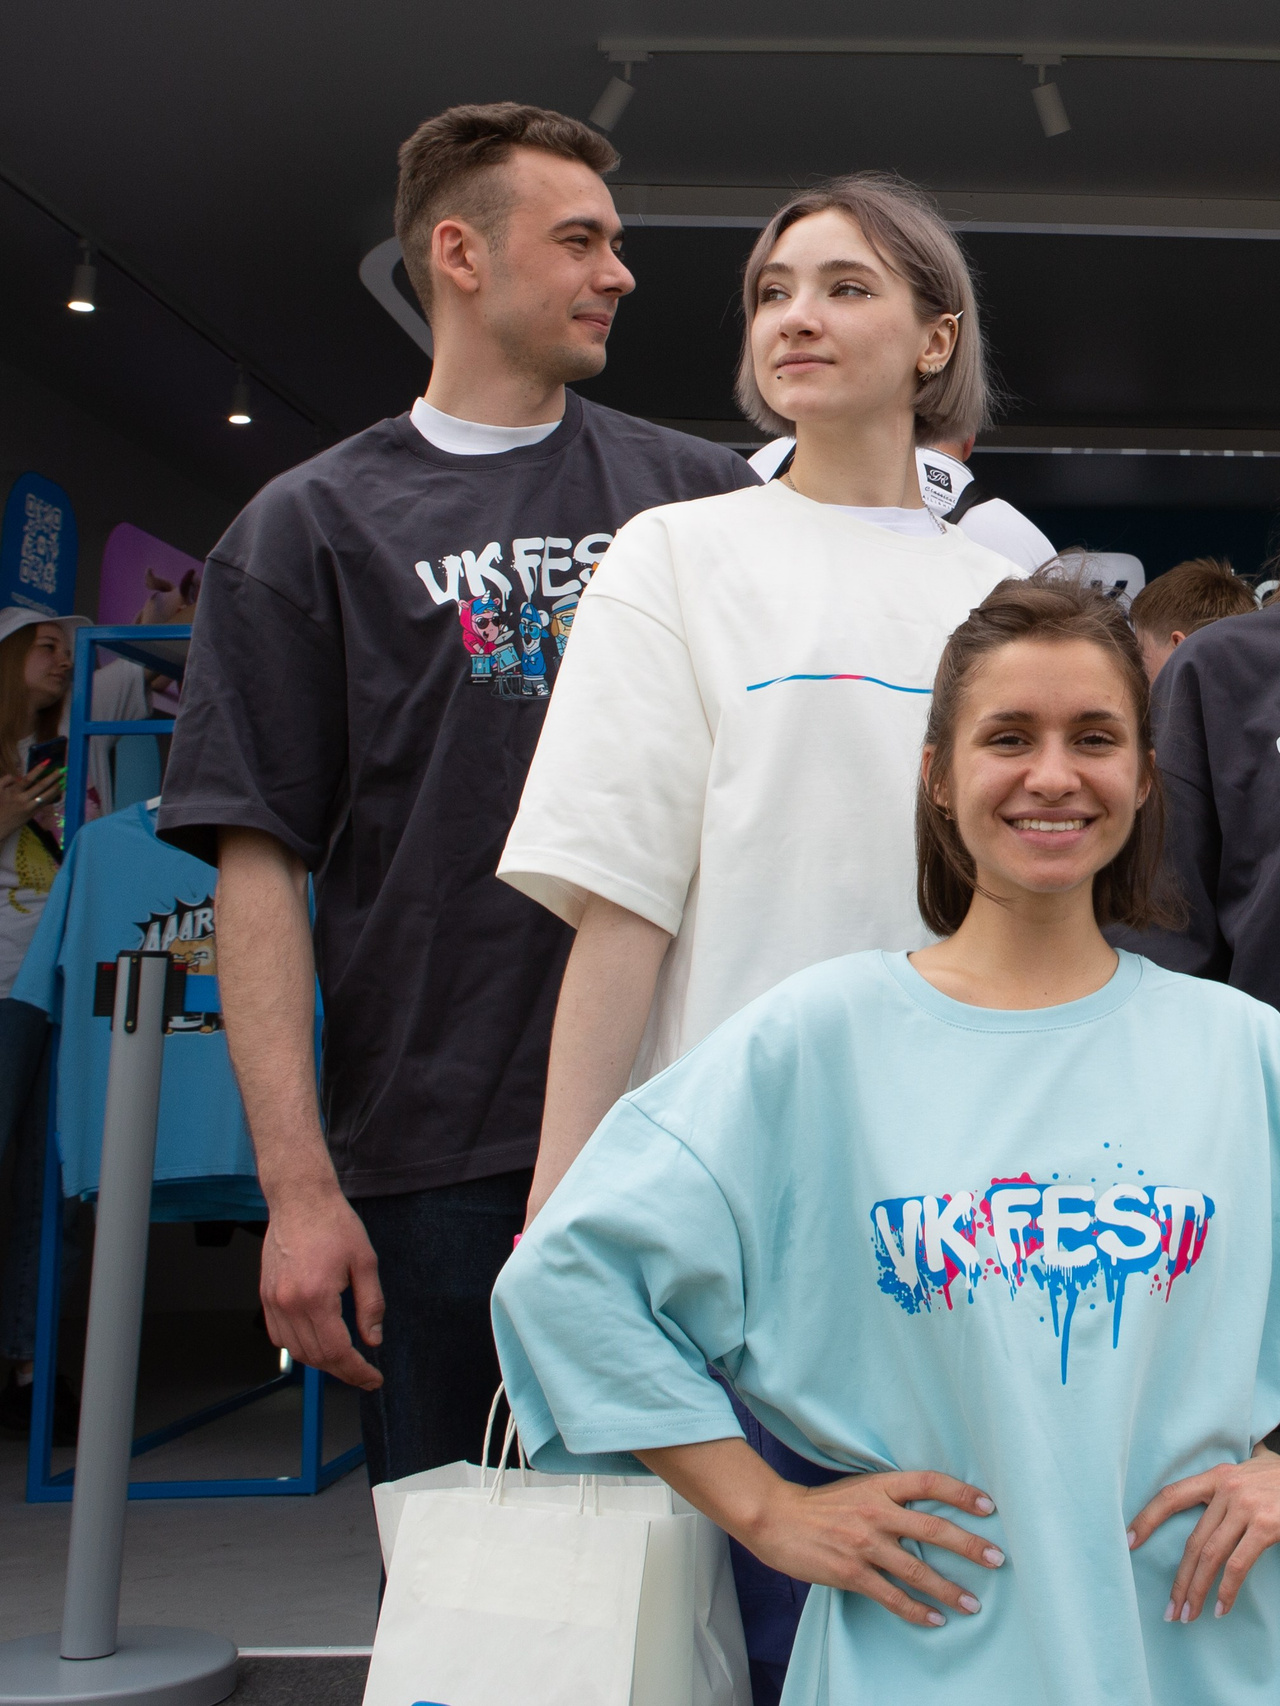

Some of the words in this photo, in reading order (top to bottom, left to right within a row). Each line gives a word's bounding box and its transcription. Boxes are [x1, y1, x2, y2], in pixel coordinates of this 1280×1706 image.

[415, 541, 512, 608] VK
[511, 531, 622, 598] FES
[144, 907, 214, 950] AAAR
[876, 1191, 980, 1292] VK
[991, 1183, 1206, 1282] FEST
